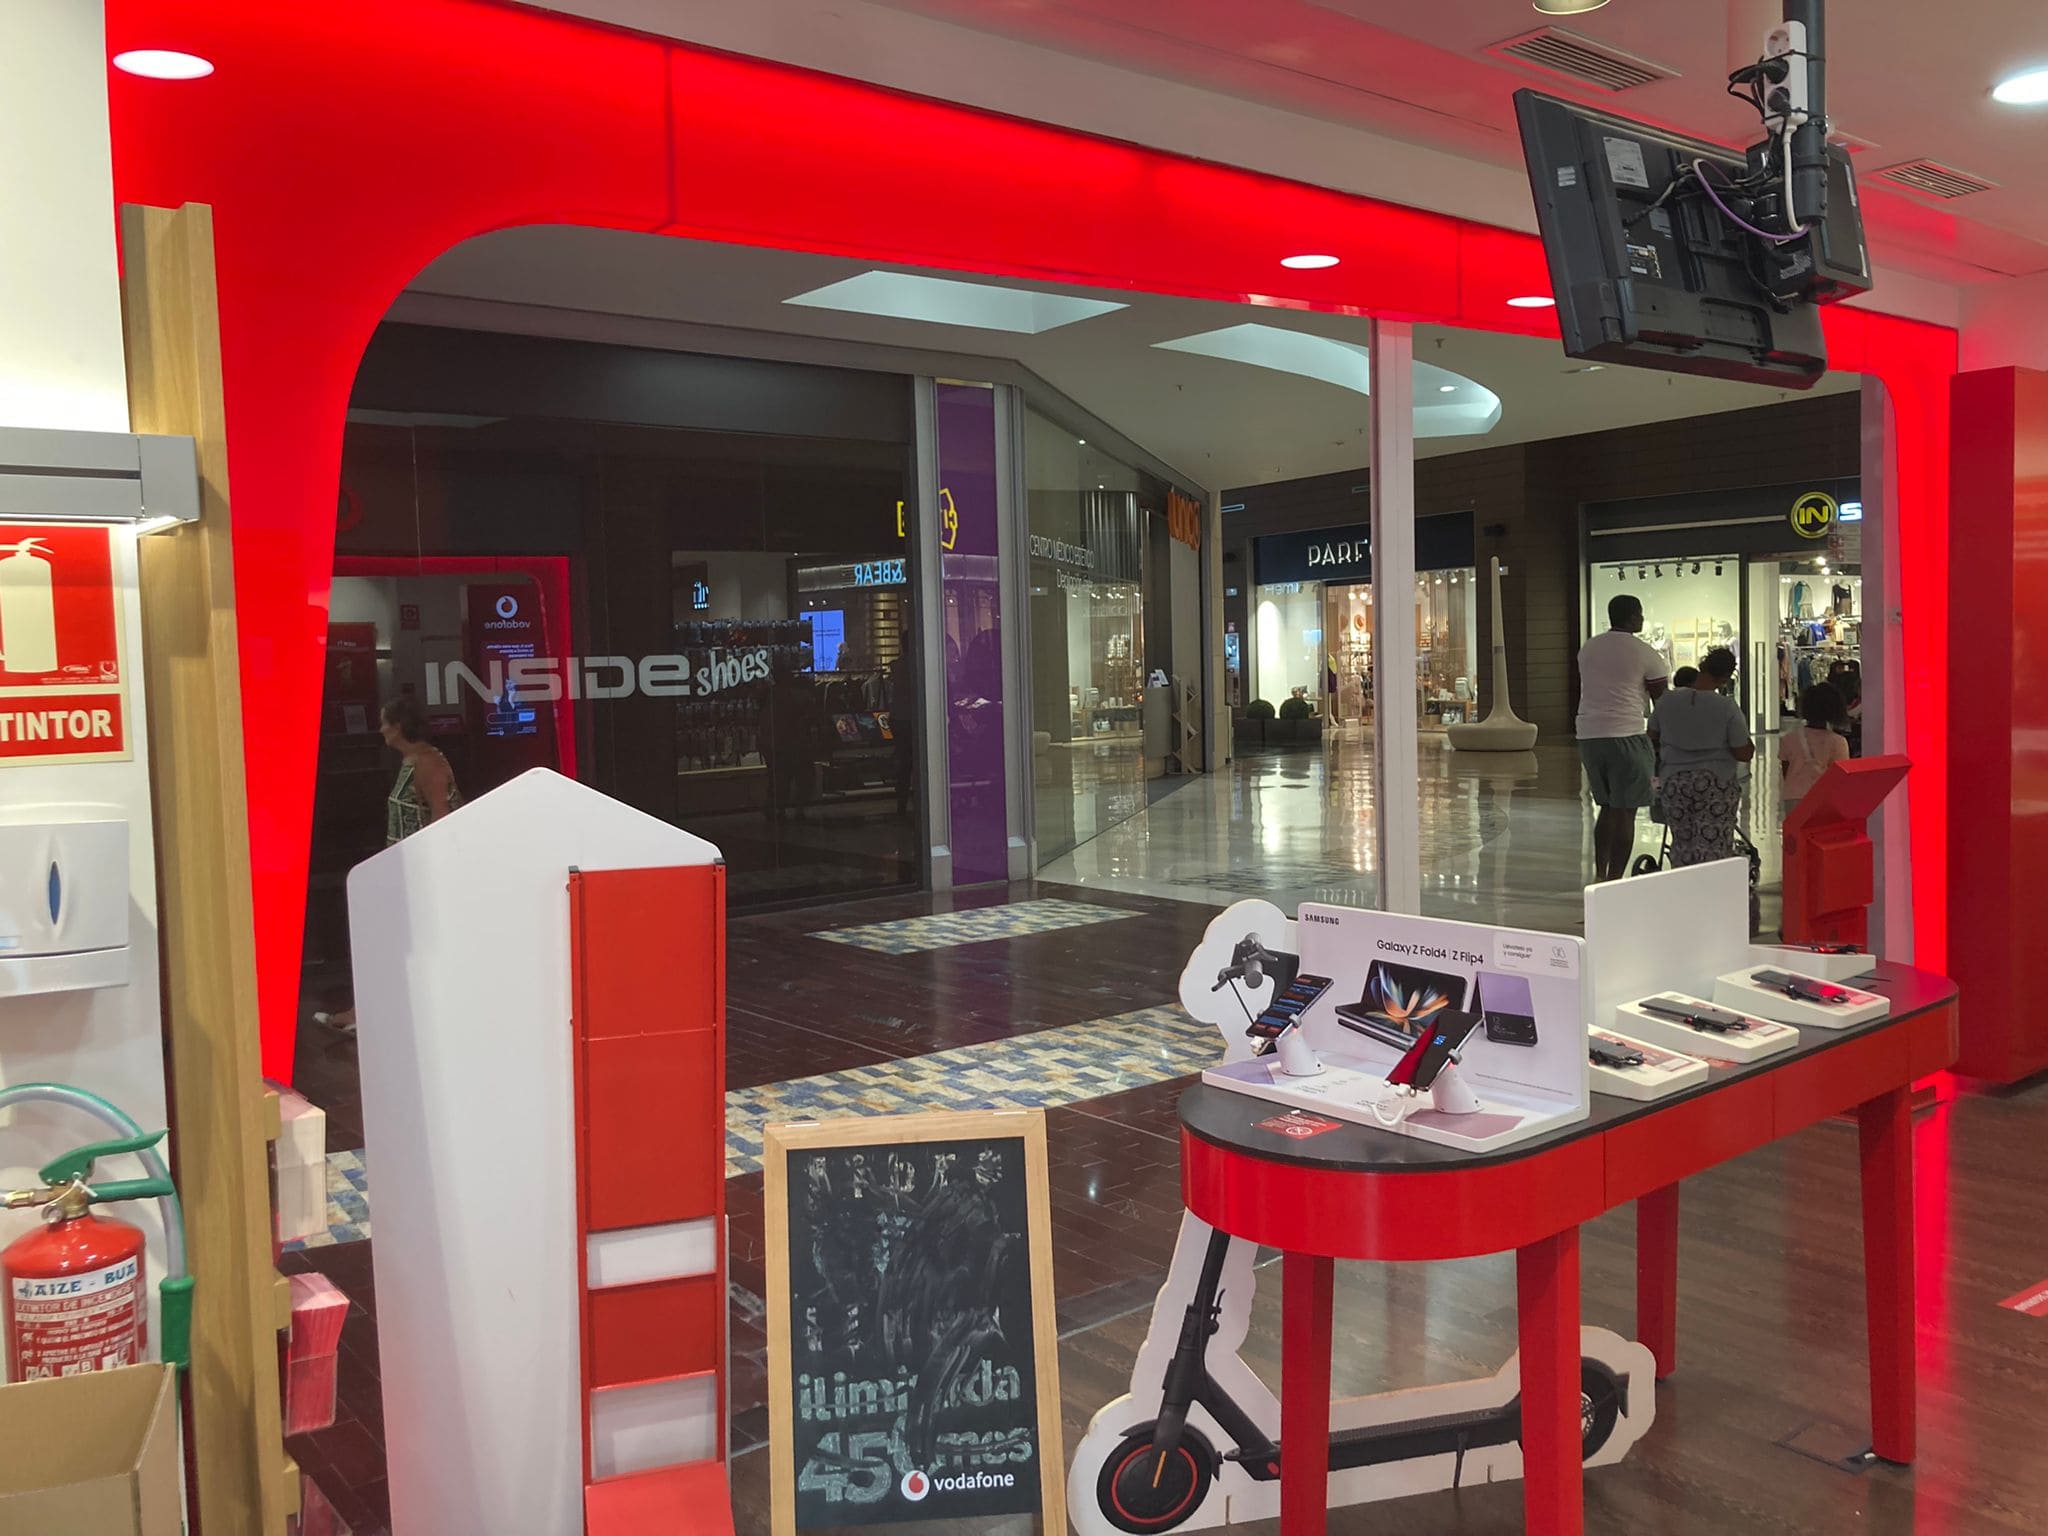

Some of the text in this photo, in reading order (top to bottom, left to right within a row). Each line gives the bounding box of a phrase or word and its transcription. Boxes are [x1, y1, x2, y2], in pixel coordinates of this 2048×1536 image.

[1308, 538, 1372, 567] PARF
[425, 649, 770, 705] INSIDE shoes
[0, 709, 114, 742] TINTOR
[1304, 913, 1340, 925] SAMSUNG
[1376, 939, 1484, 966] Galaxy Z Fold4 Z Flip4
[799, 1357, 1021, 1421] ilimida
[934, 1471, 1015, 1491] vodafone
